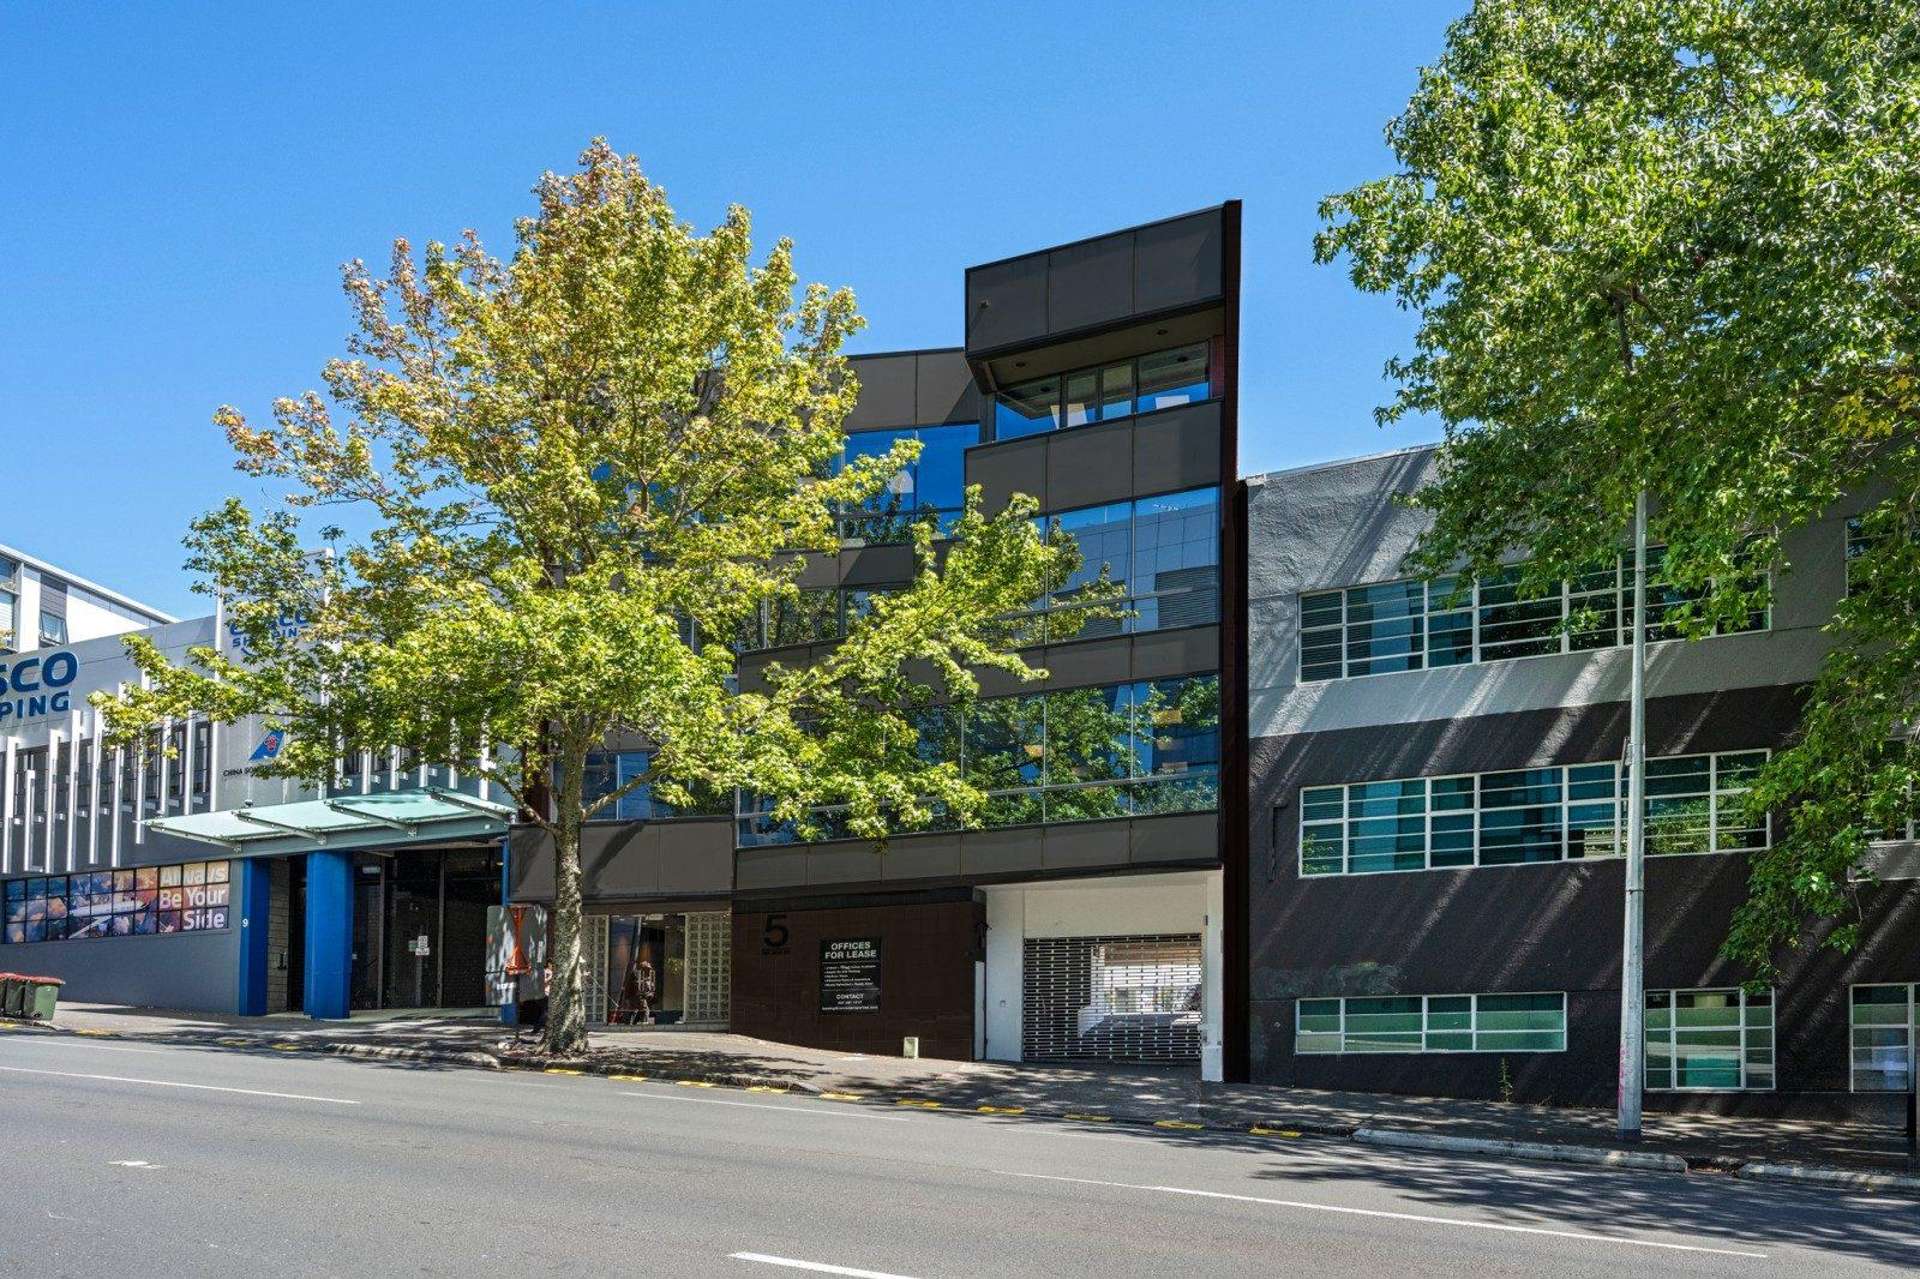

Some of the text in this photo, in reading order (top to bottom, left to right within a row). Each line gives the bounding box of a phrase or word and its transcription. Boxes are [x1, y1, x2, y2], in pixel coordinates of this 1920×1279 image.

[0, 651, 78, 697] CO
[159, 885, 226, 909] Be Your
[183, 908, 225, 930] Side
[242, 918, 249, 928] 9
[764, 914, 789, 947] 5
[825, 949, 877, 959] FOR LEASE
[831, 941, 871, 950] OFFICES
